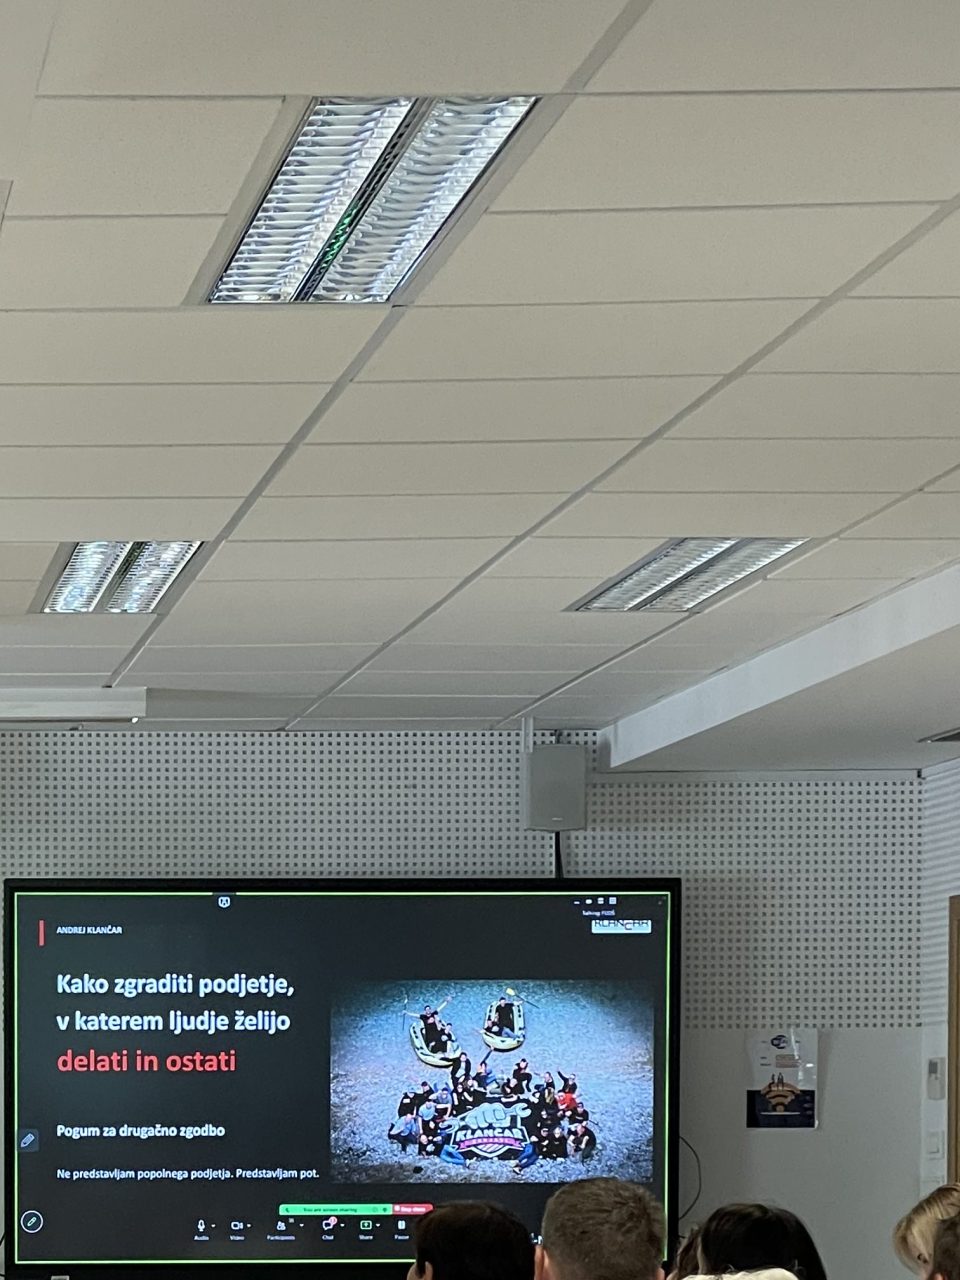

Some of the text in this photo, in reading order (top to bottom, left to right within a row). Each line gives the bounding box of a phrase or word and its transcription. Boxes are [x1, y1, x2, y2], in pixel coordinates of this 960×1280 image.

[56, 924, 122, 934] ANDREJ KLANČAR
[57, 973, 295, 998] Kako zgraditi podjetje,
[56, 1010, 291, 1035] v katerem ljudje želijo
[57, 1049, 237, 1072] delati in ostati
[57, 1124, 225, 1139] Pogum za drugačno zgodbo
[57, 1168, 319, 1180] Ne predstavljam popolnega podjetja. Predstavljam pot.
